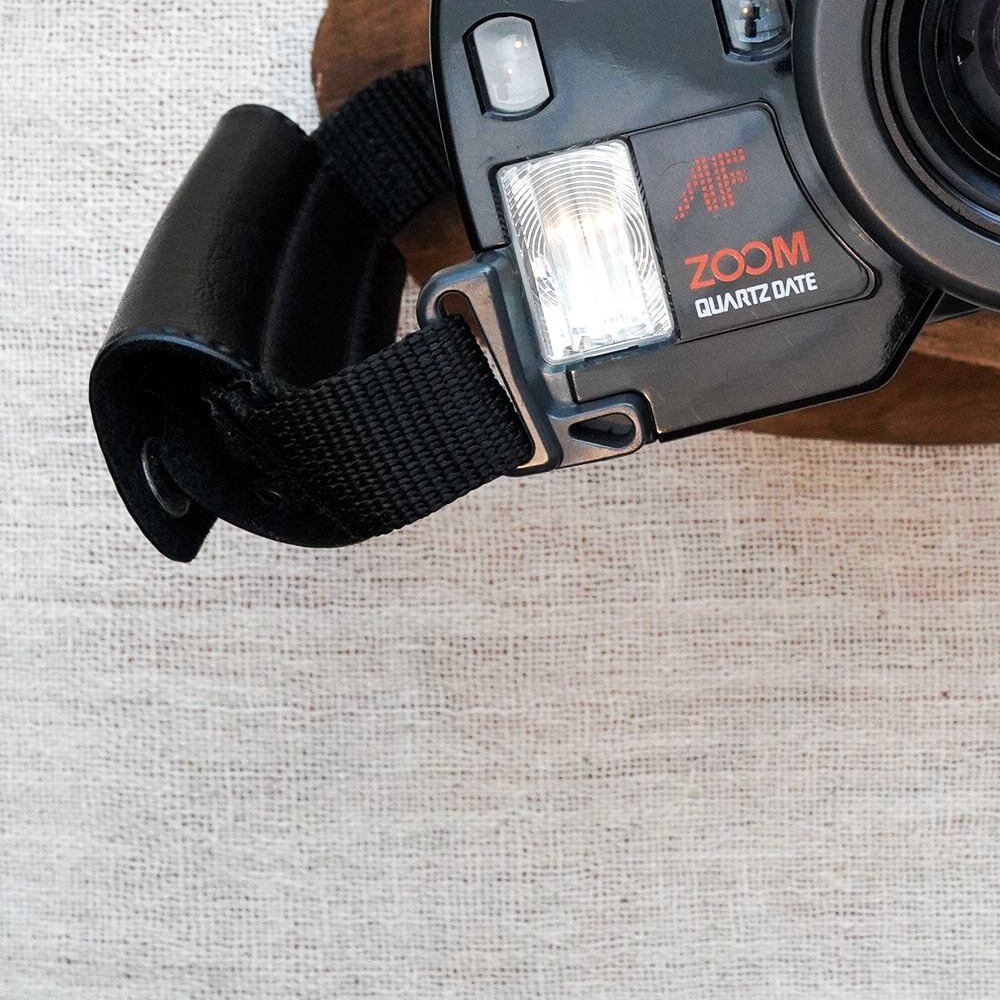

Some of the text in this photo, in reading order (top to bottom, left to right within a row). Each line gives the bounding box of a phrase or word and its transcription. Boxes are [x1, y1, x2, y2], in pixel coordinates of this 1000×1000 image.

[673, 146, 750, 221] AF
[683, 229, 811, 290] ZOOM
[694, 271, 818, 319] QUARTZ DATE
